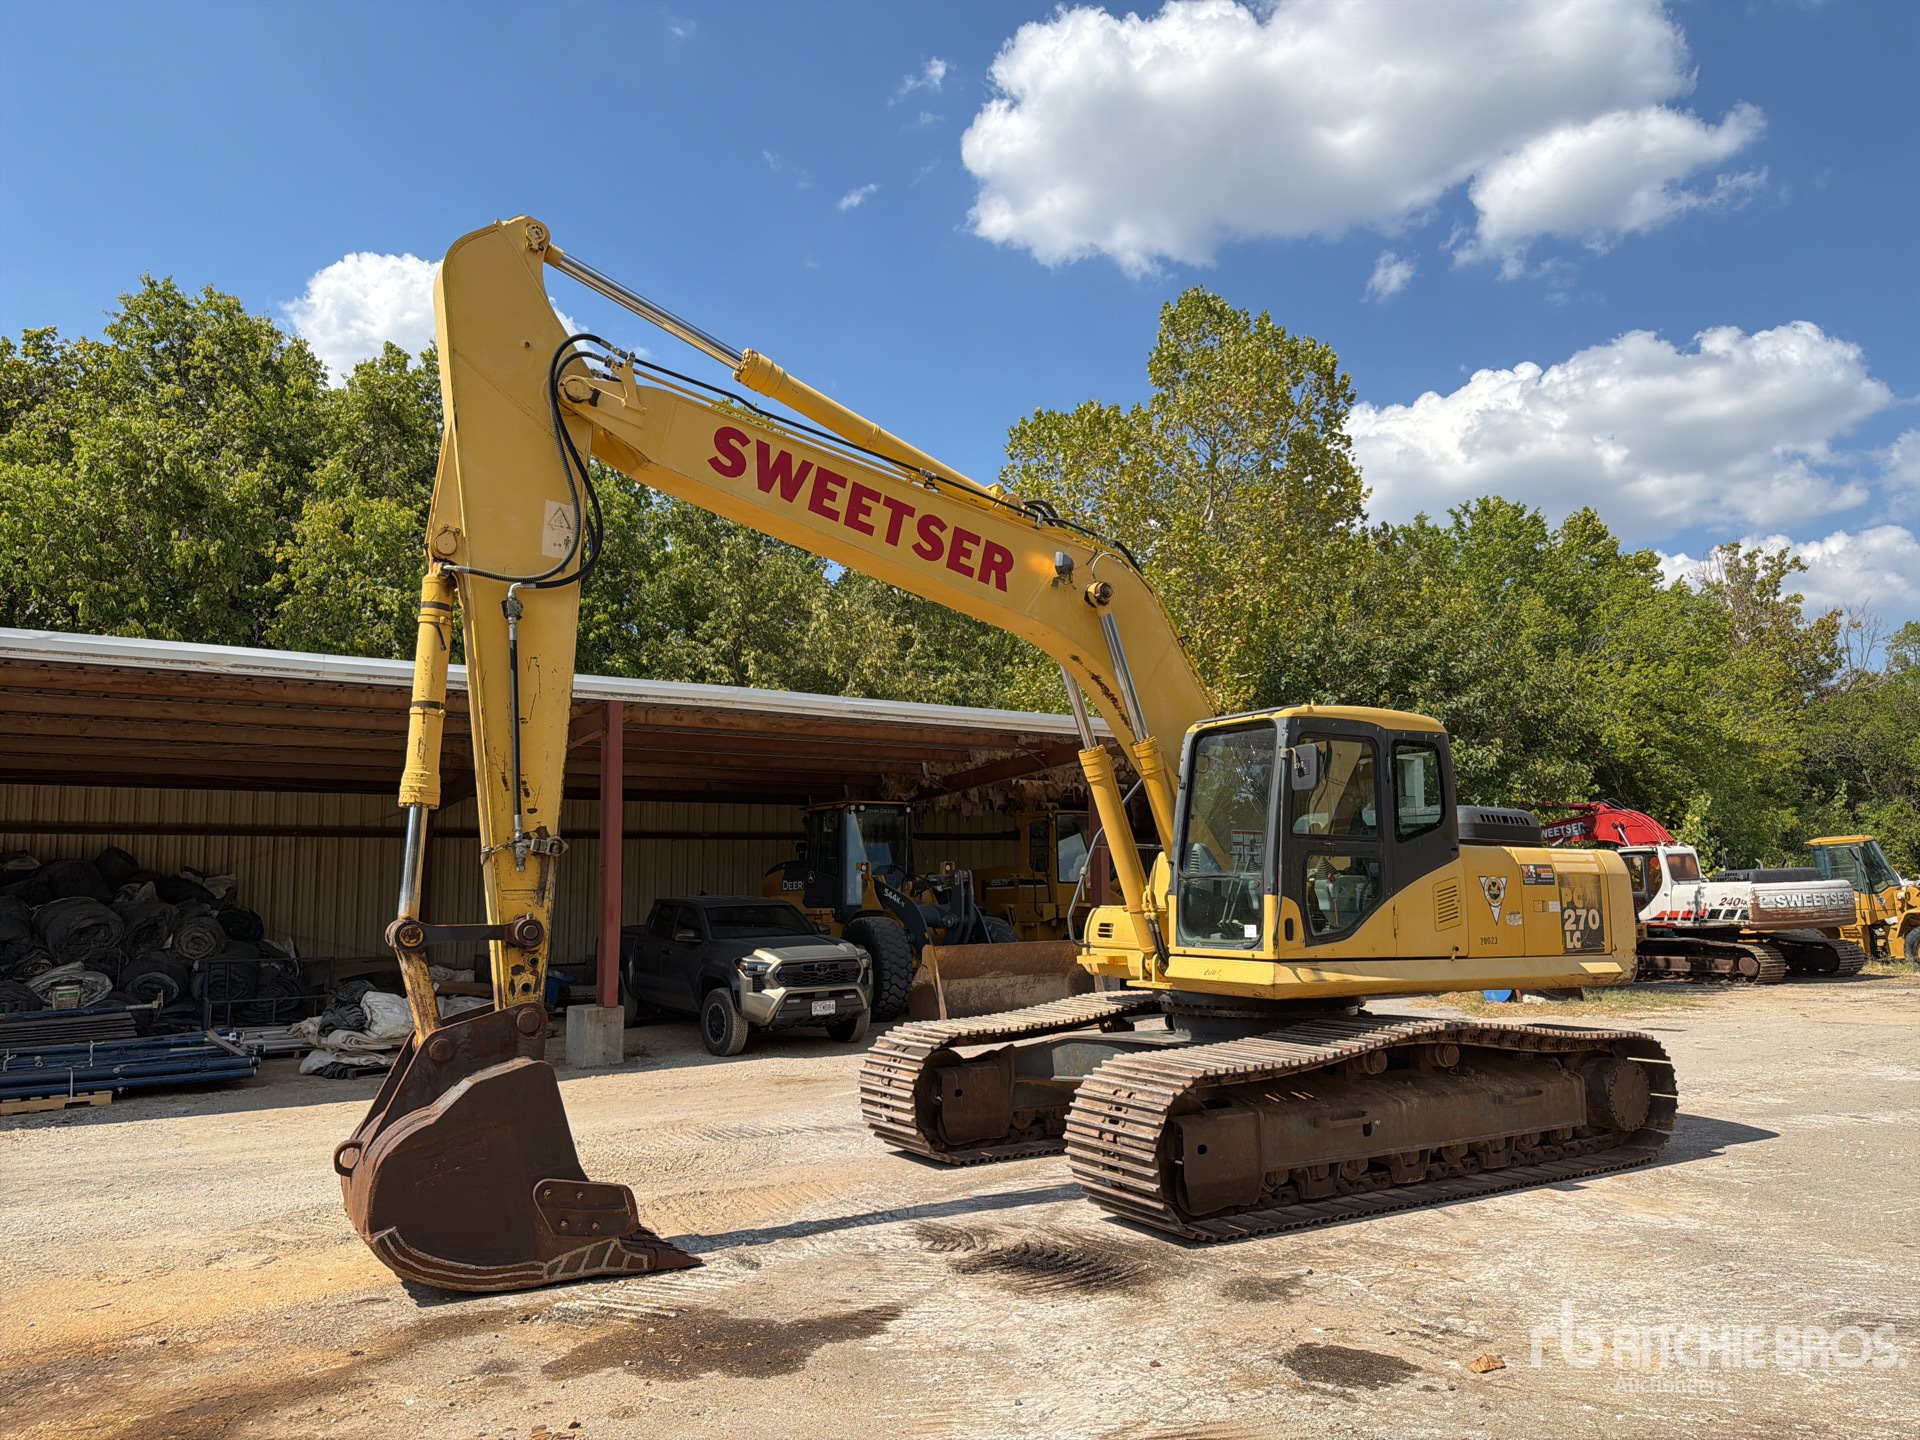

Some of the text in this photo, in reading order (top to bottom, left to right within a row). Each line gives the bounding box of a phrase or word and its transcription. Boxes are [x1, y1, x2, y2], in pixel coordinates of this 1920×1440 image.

[707, 426, 1014, 593] SWEETSER
[782, 879, 805, 891] DEER
[1561, 887, 1584, 908] PC
[1775, 891, 1850, 908] SWEETSER
[1563, 908, 1600, 931] 270
[1565, 930, 1582, 949] LC
